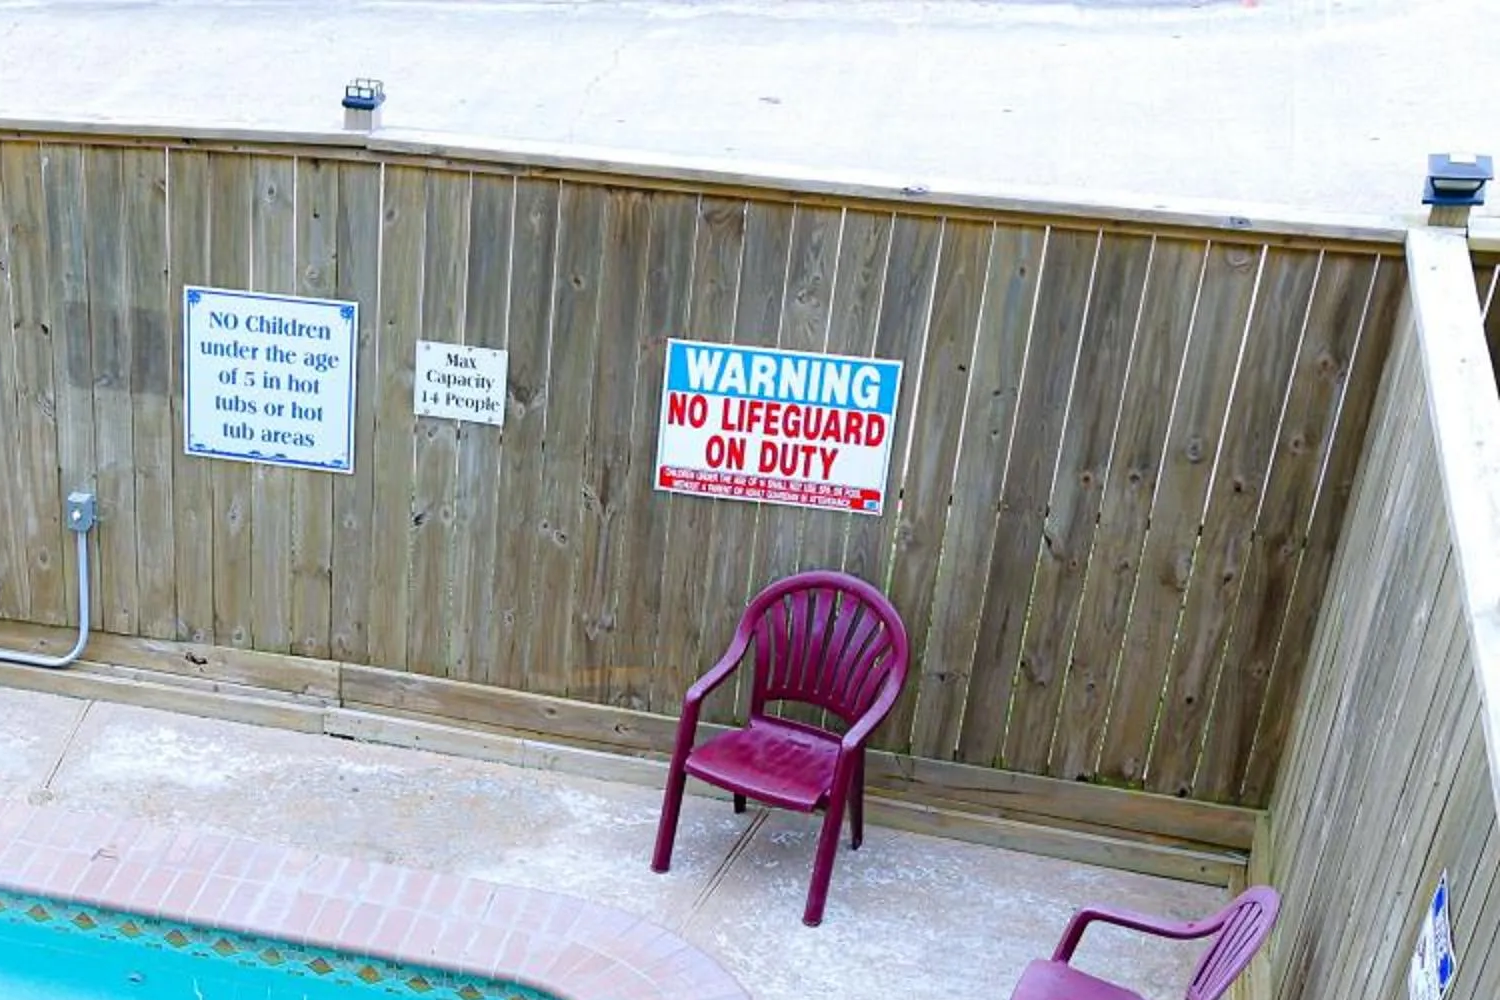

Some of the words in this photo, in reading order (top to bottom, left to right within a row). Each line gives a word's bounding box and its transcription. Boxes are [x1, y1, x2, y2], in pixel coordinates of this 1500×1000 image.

[209, 311, 238, 331] NO
[245, 314, 332, 340] Children
[200, 338, 259, 360] under
[265, 342, 297, 365] the
[303, 350, 340, 373] age
[445, 353, 477, 370] Max
[218, 368, 238, 385] of
[243, 371, 256, 387] 5
[262, 371, 282, 390] in
[288, 374, 320, 395] hot
[426, 368, 496, 393] Capacity
[685, 347, 881, 409] WARNING
[215, 394, 258, 415] tubs
[263, 402, 285, 418] or
[291, 401, 324, 422] hot
[420, 390, 439, 405] 14
[445, 393, 500, 414] People
[668, 392, 708, 428] NO
[721, 398, 885, 447] LIFEGUARD
[222, 422, 254, 441] tub
[261, 429, 315, 448] areas
[705, 435, 746, 470] ON
[758, 440, 839, 481] DUTY
